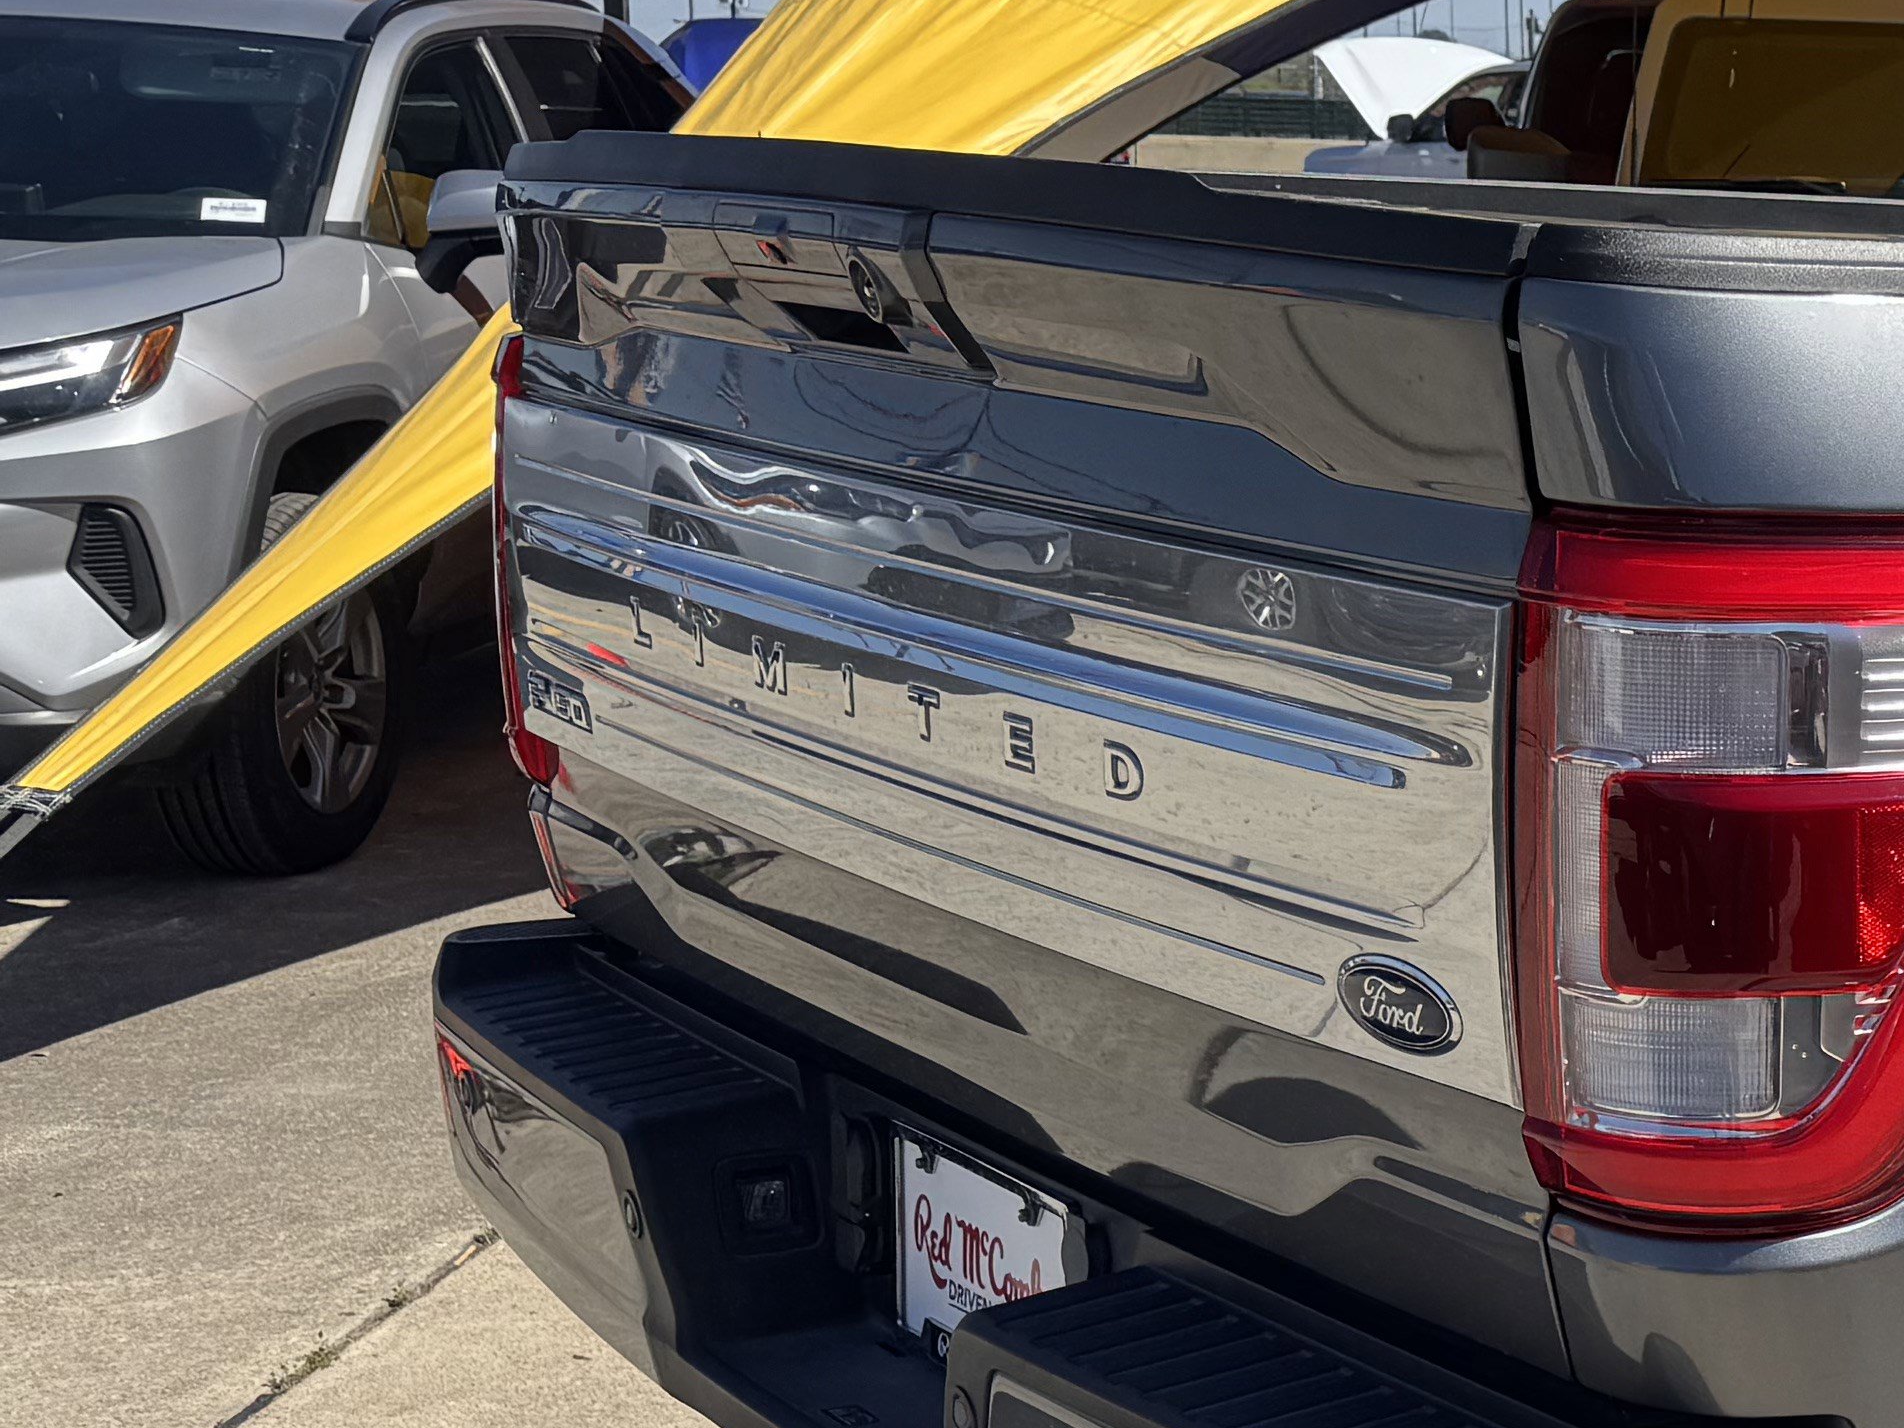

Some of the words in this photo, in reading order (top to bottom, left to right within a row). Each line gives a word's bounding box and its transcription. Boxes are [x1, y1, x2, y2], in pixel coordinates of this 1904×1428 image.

[629, 595, 1145, 801] LIMITED
[1360, 975, 1424, 1035] Ford
[914, 1193, 952, 1290] Red
